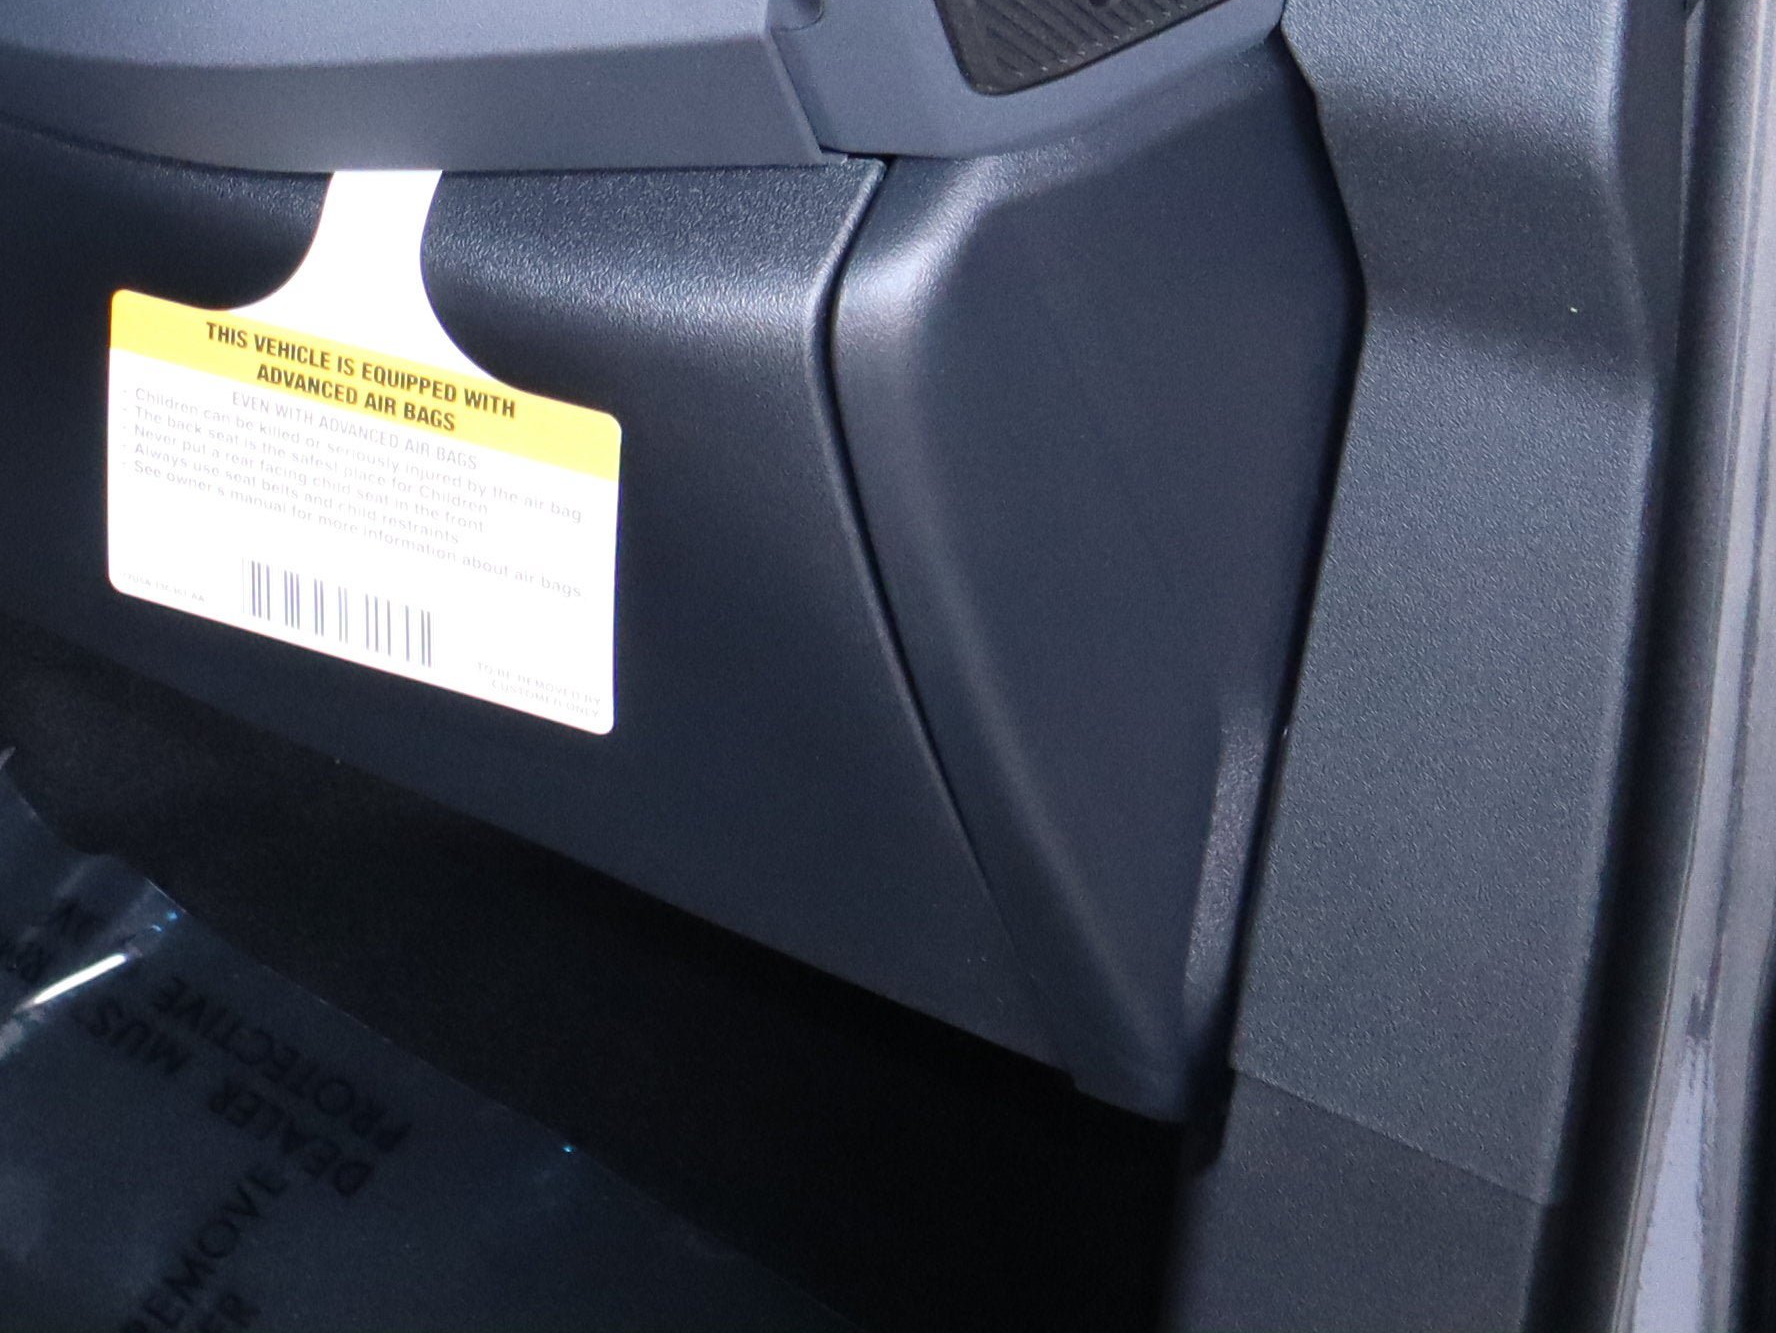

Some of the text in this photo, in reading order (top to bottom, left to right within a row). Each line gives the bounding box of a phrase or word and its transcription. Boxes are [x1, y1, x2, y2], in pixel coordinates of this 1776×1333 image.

[205, 320, 516, 420] THIS VEHICLE IS EQUIPPED WITH
[256, 363, 456, 433] ADVANCED AIR BAGS
[134, 423, 485, 533] Never put a rear facing child seat in the front
[135, 387, 583, 524] Children can be killed or seriously injured by the air bag
[135, 405, 489, 515] The back seat is the safest place for Children
[232, 390, 478, 471] EVEN WITH ADVANCED AIR BAGS
[134, 442, 460, 545] Always use seat belts and child restraints
[134, 459, 162, 478] See
[230, 490, 287, 514] manual
[291, 504, 313, 521] for
[318, 515, 359, 534] more
[363, 523, 457, 562] information
[461, 554, 509, 577] about
[514, 569, 536, 584] air
[540, 574, 583, 600] bags
[208, 1075, 378, 1199] DEALER
